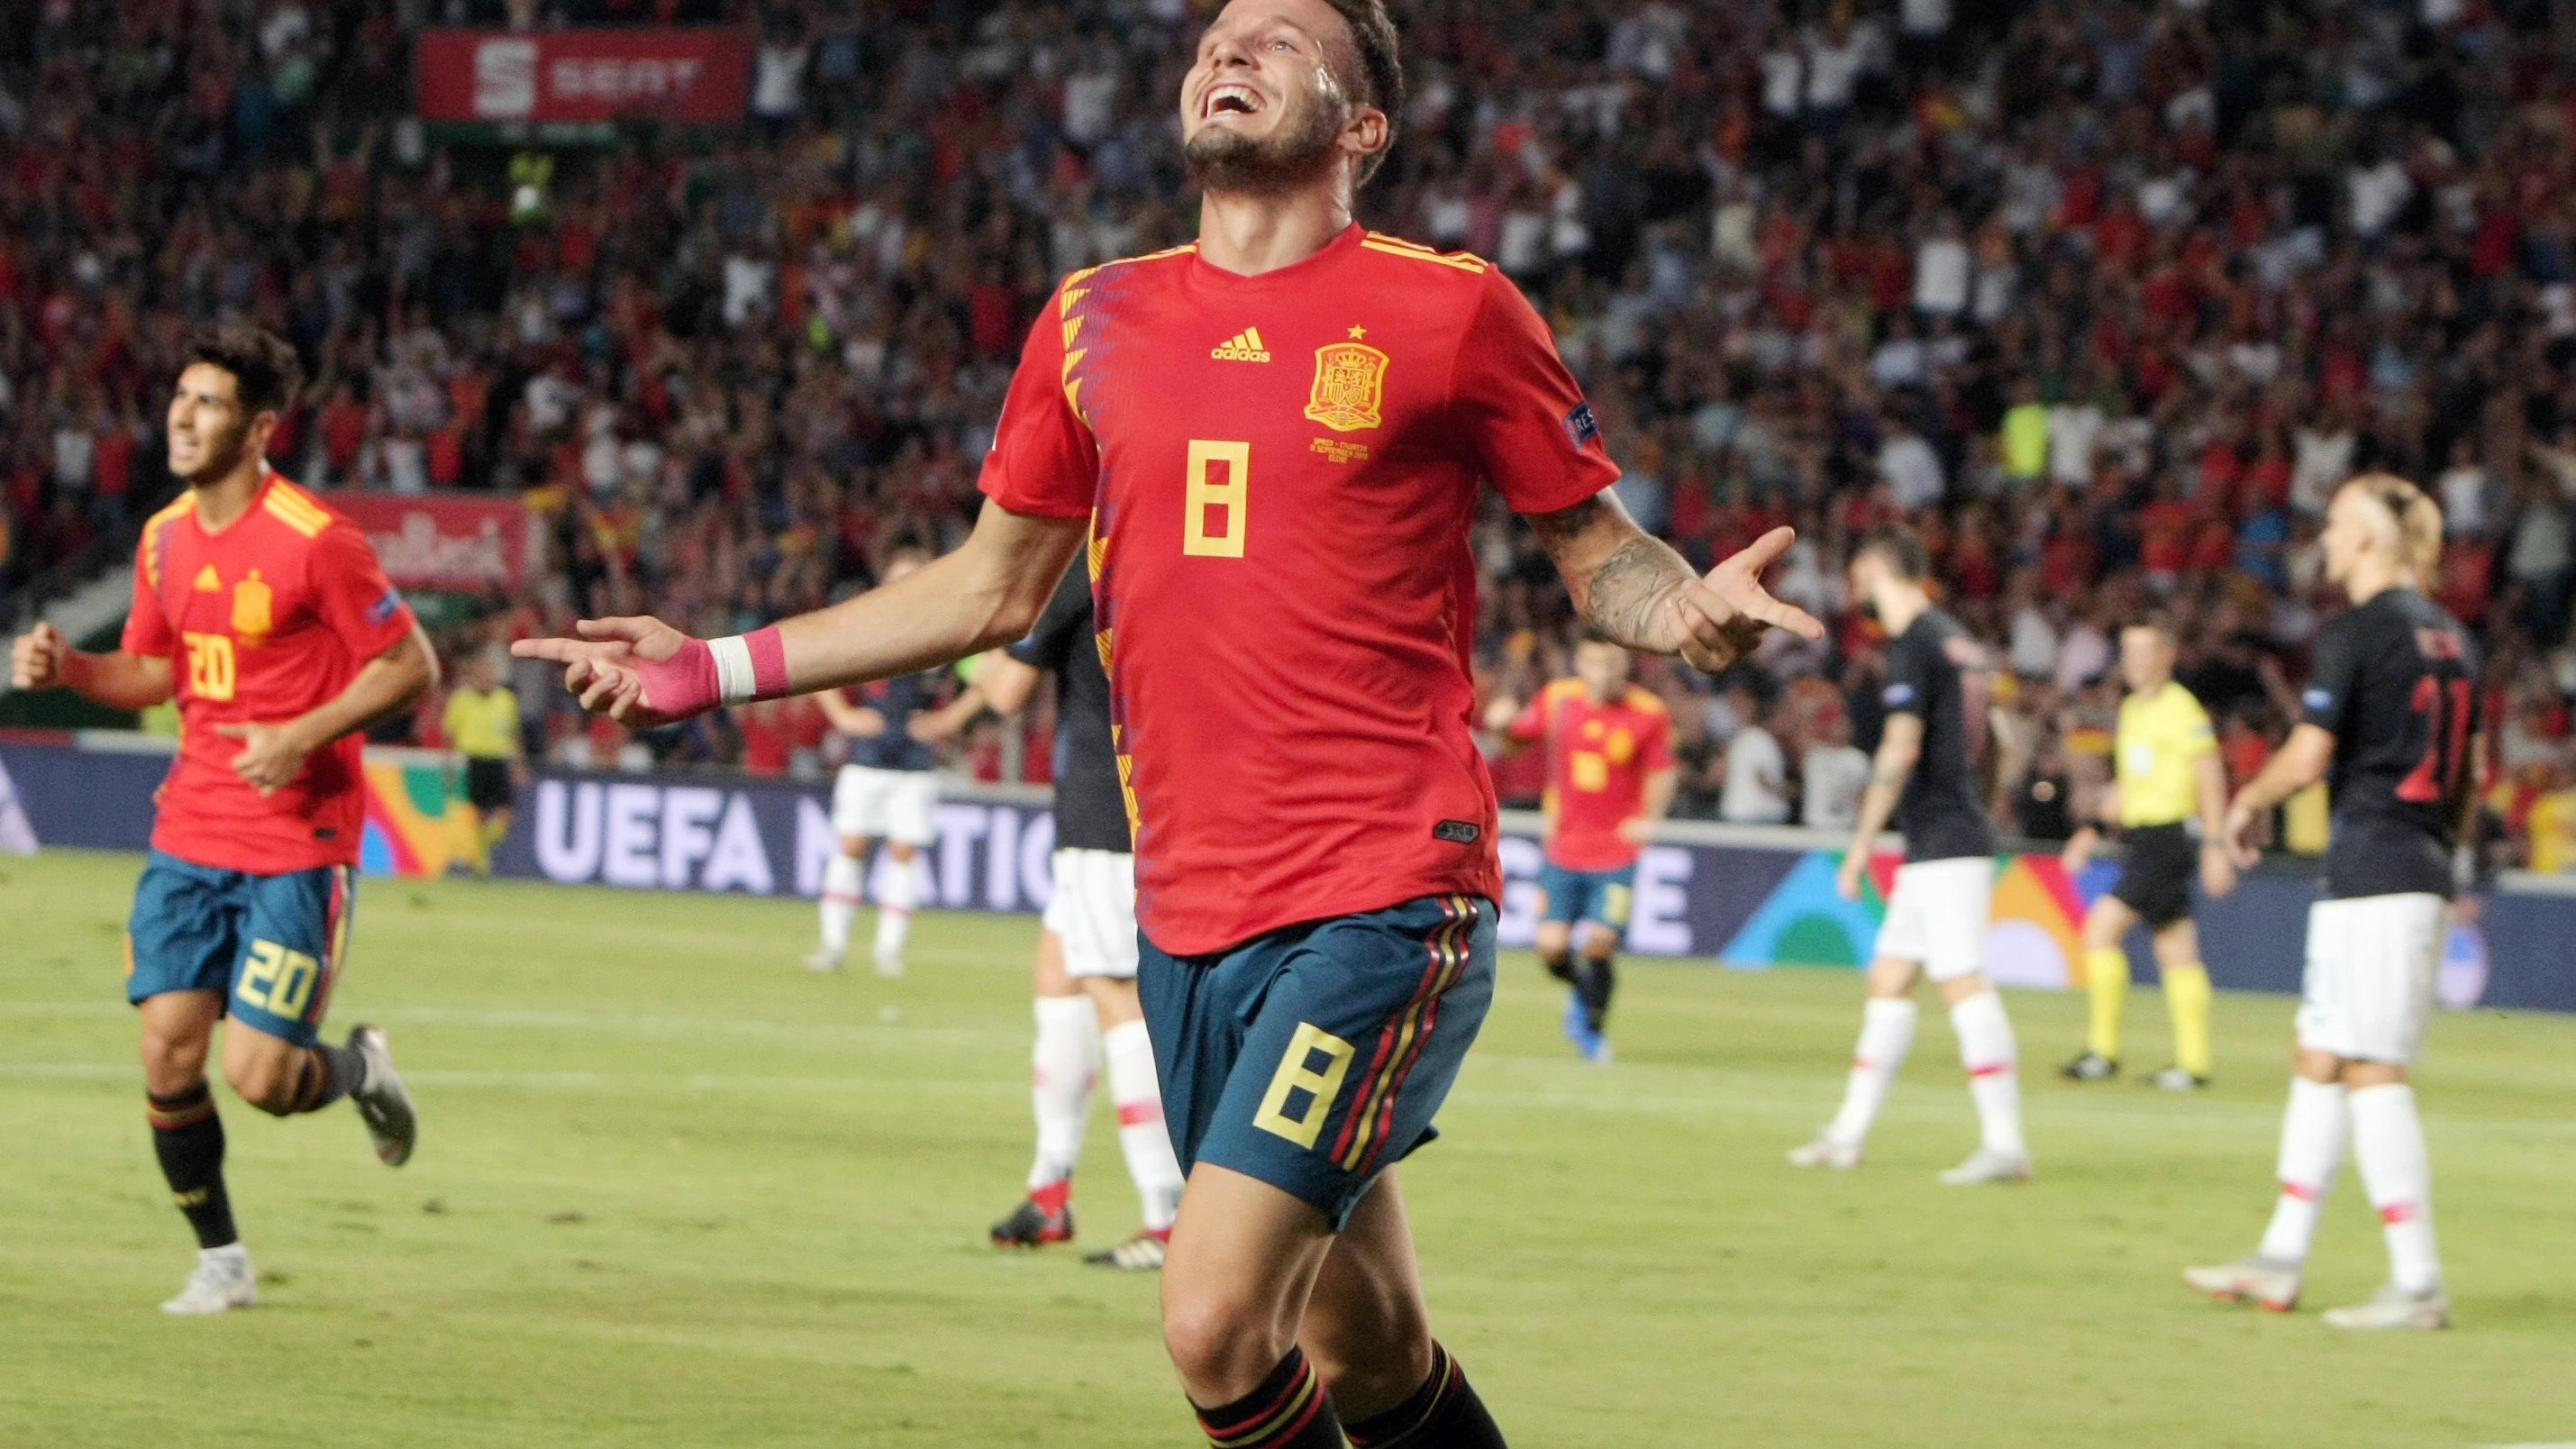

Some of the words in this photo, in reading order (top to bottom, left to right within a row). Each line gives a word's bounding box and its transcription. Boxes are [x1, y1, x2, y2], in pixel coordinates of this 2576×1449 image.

[1210, 347, 1271, 363] adidas
[1183, 439, 1251, 559] 8
[182, 630, 235, 702] 20
[535, 782, 772, 896] UEFA
[236, 937, 319, 1020] 20
[1252, 1021, 1356, 1150] 8
